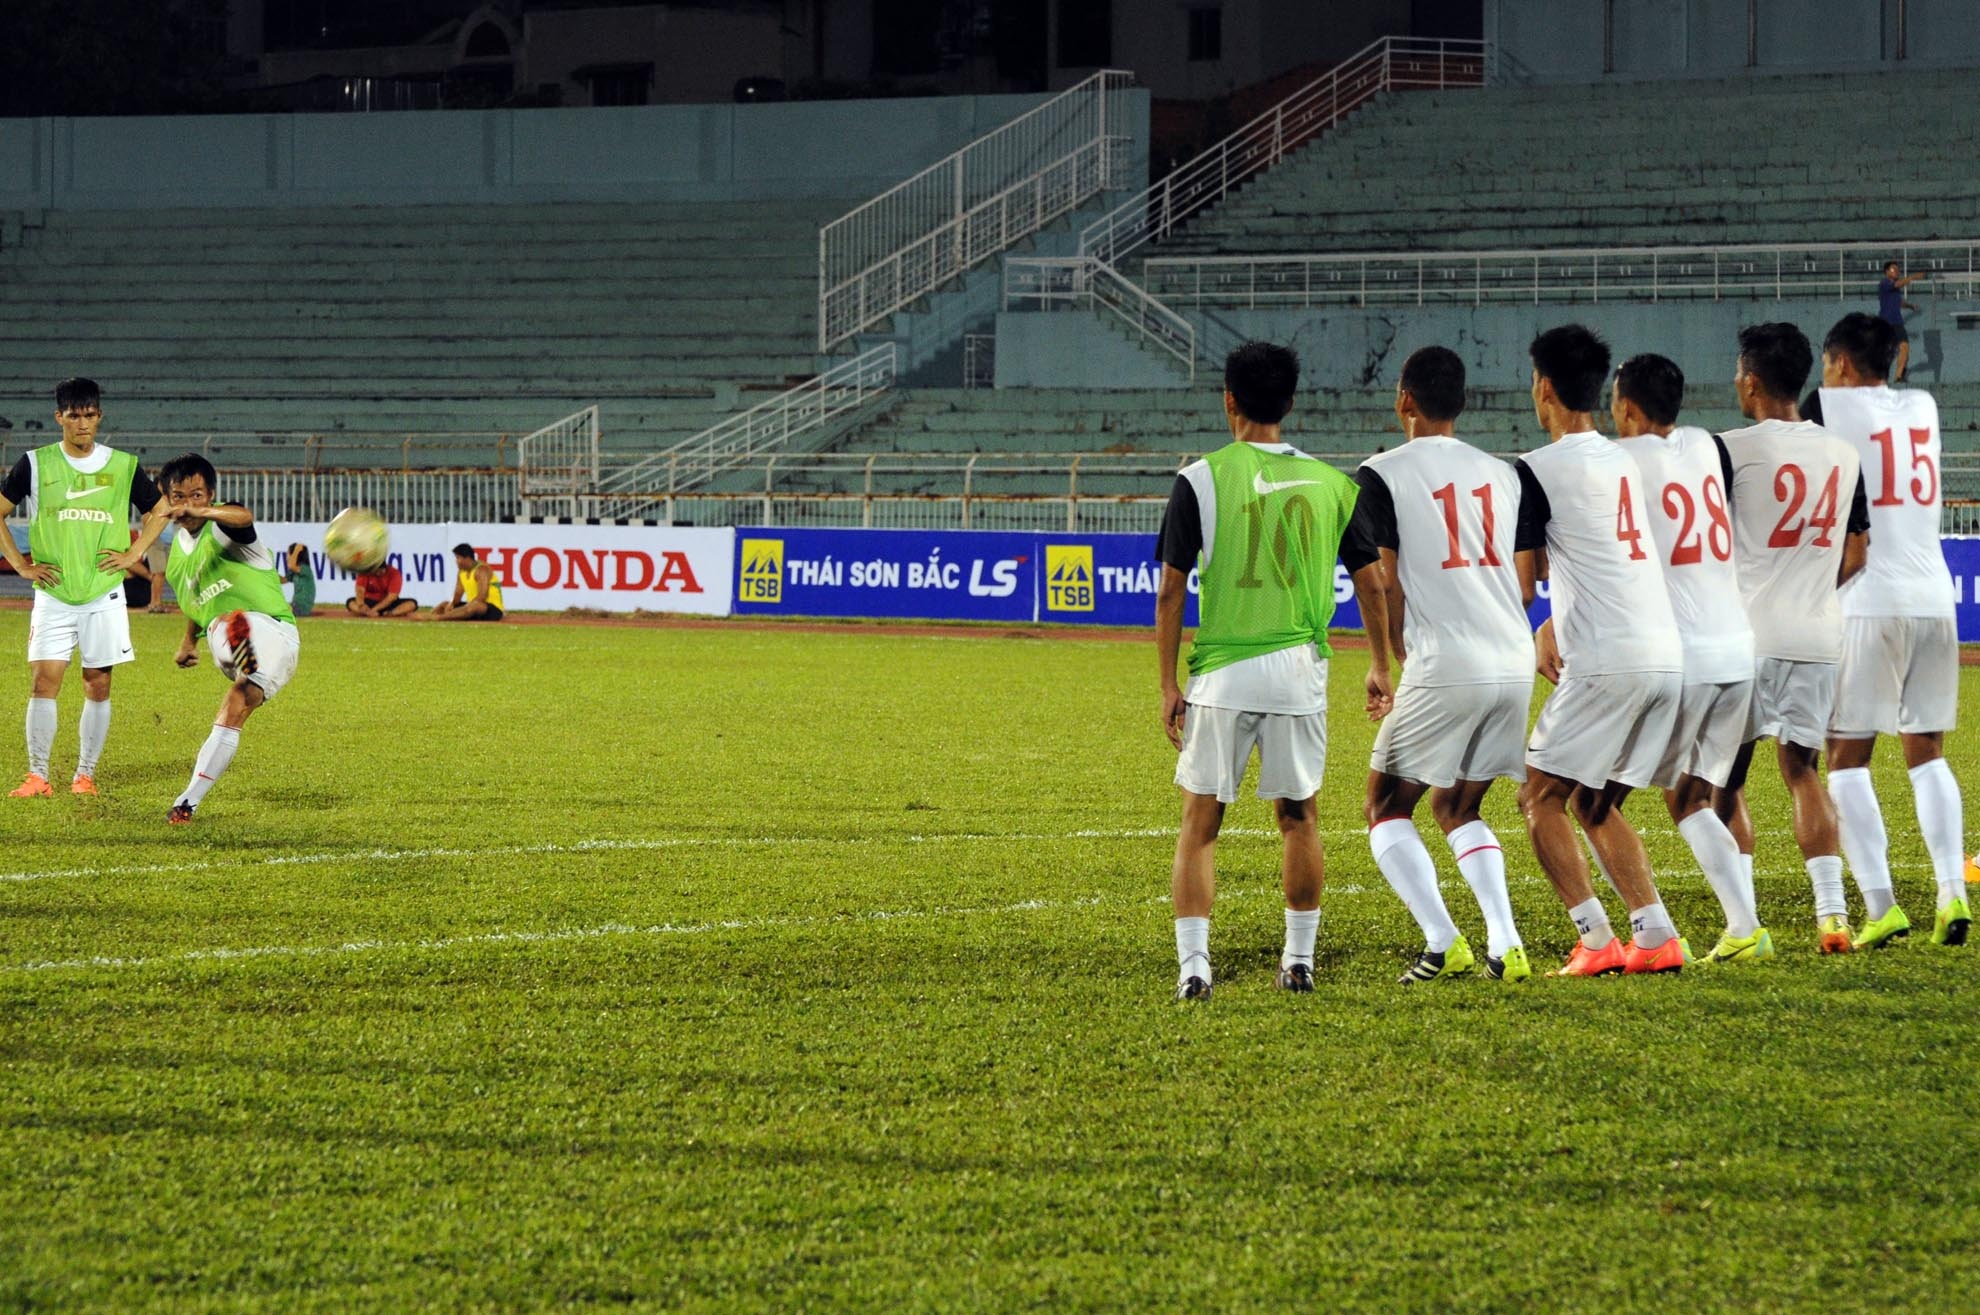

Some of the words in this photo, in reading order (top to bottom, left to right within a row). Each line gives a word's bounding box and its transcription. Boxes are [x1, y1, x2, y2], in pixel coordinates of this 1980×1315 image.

[1767, 463, 1840, 549] 24
[1870, 427, 1937, 507] 15
[58, 508, 114, 524] HONDA
[1235, 493, 1314, 590] 10
[1432, 482, 1502, 570] 11
[1616, 476, 1647, 561] 4
[1661, 475, 1732, 567] 28
[473, 546, 704, 594] HONDA
[743, 577, 780, 598] TSB
[787, 555, 843, 586] THÁI
[849, 559, 900, 588] SƠN
[907, 547, 960, 589] BẮC
[968, 559, 1018, 597] LS
[1050, 585, 1091, 606] TSB
